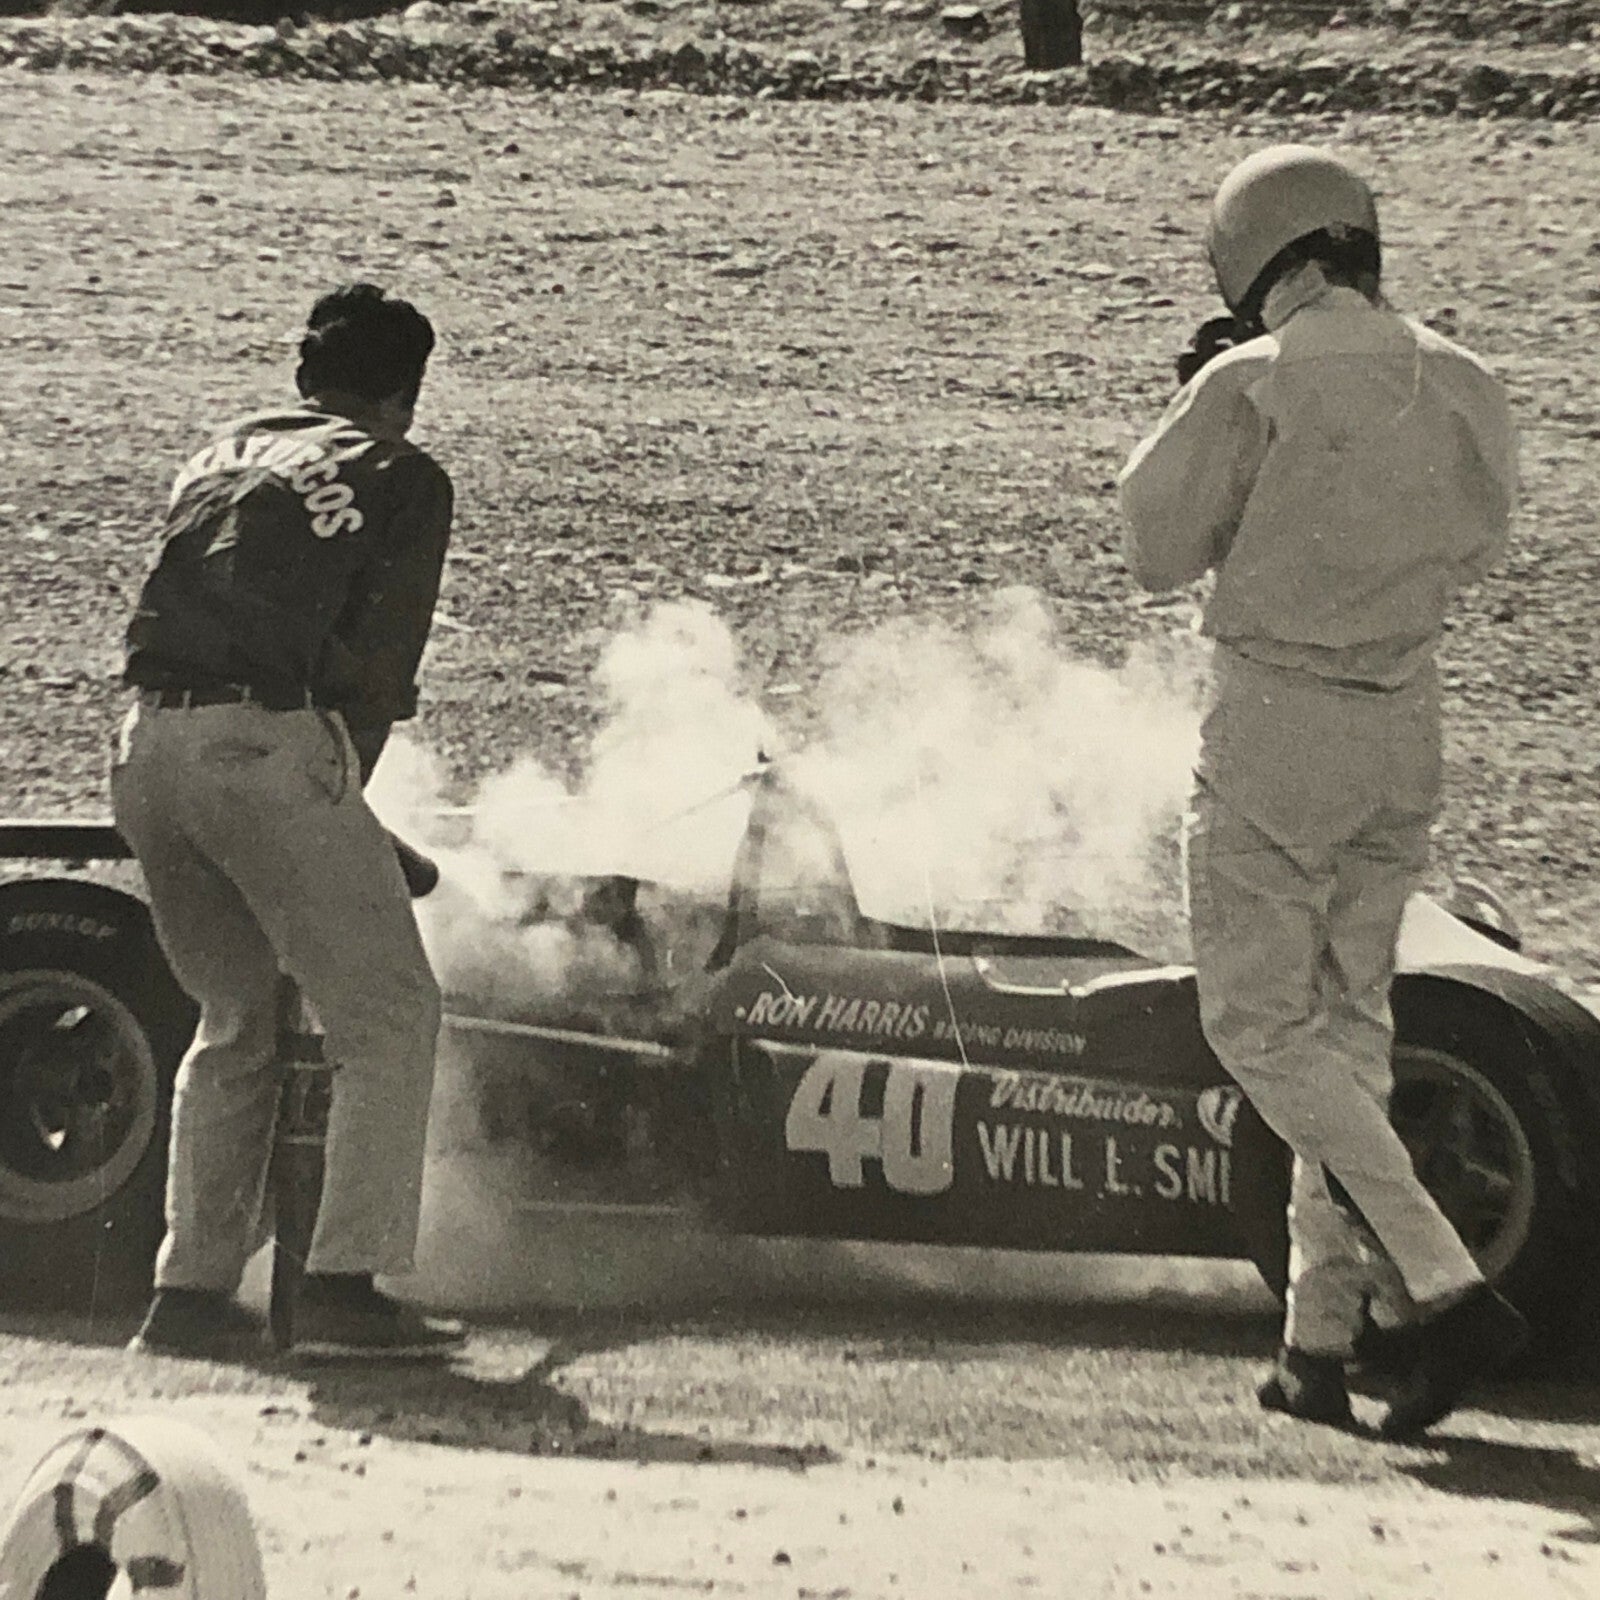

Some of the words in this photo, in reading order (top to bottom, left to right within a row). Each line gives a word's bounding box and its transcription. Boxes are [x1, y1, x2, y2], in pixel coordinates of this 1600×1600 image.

[746, 991, 819, 1029] RON
[813, 993, 930, 1038] HARRIS
[785, 1053, 961, 1193] 40
[977, 1120, 1084, 1190] WILL
